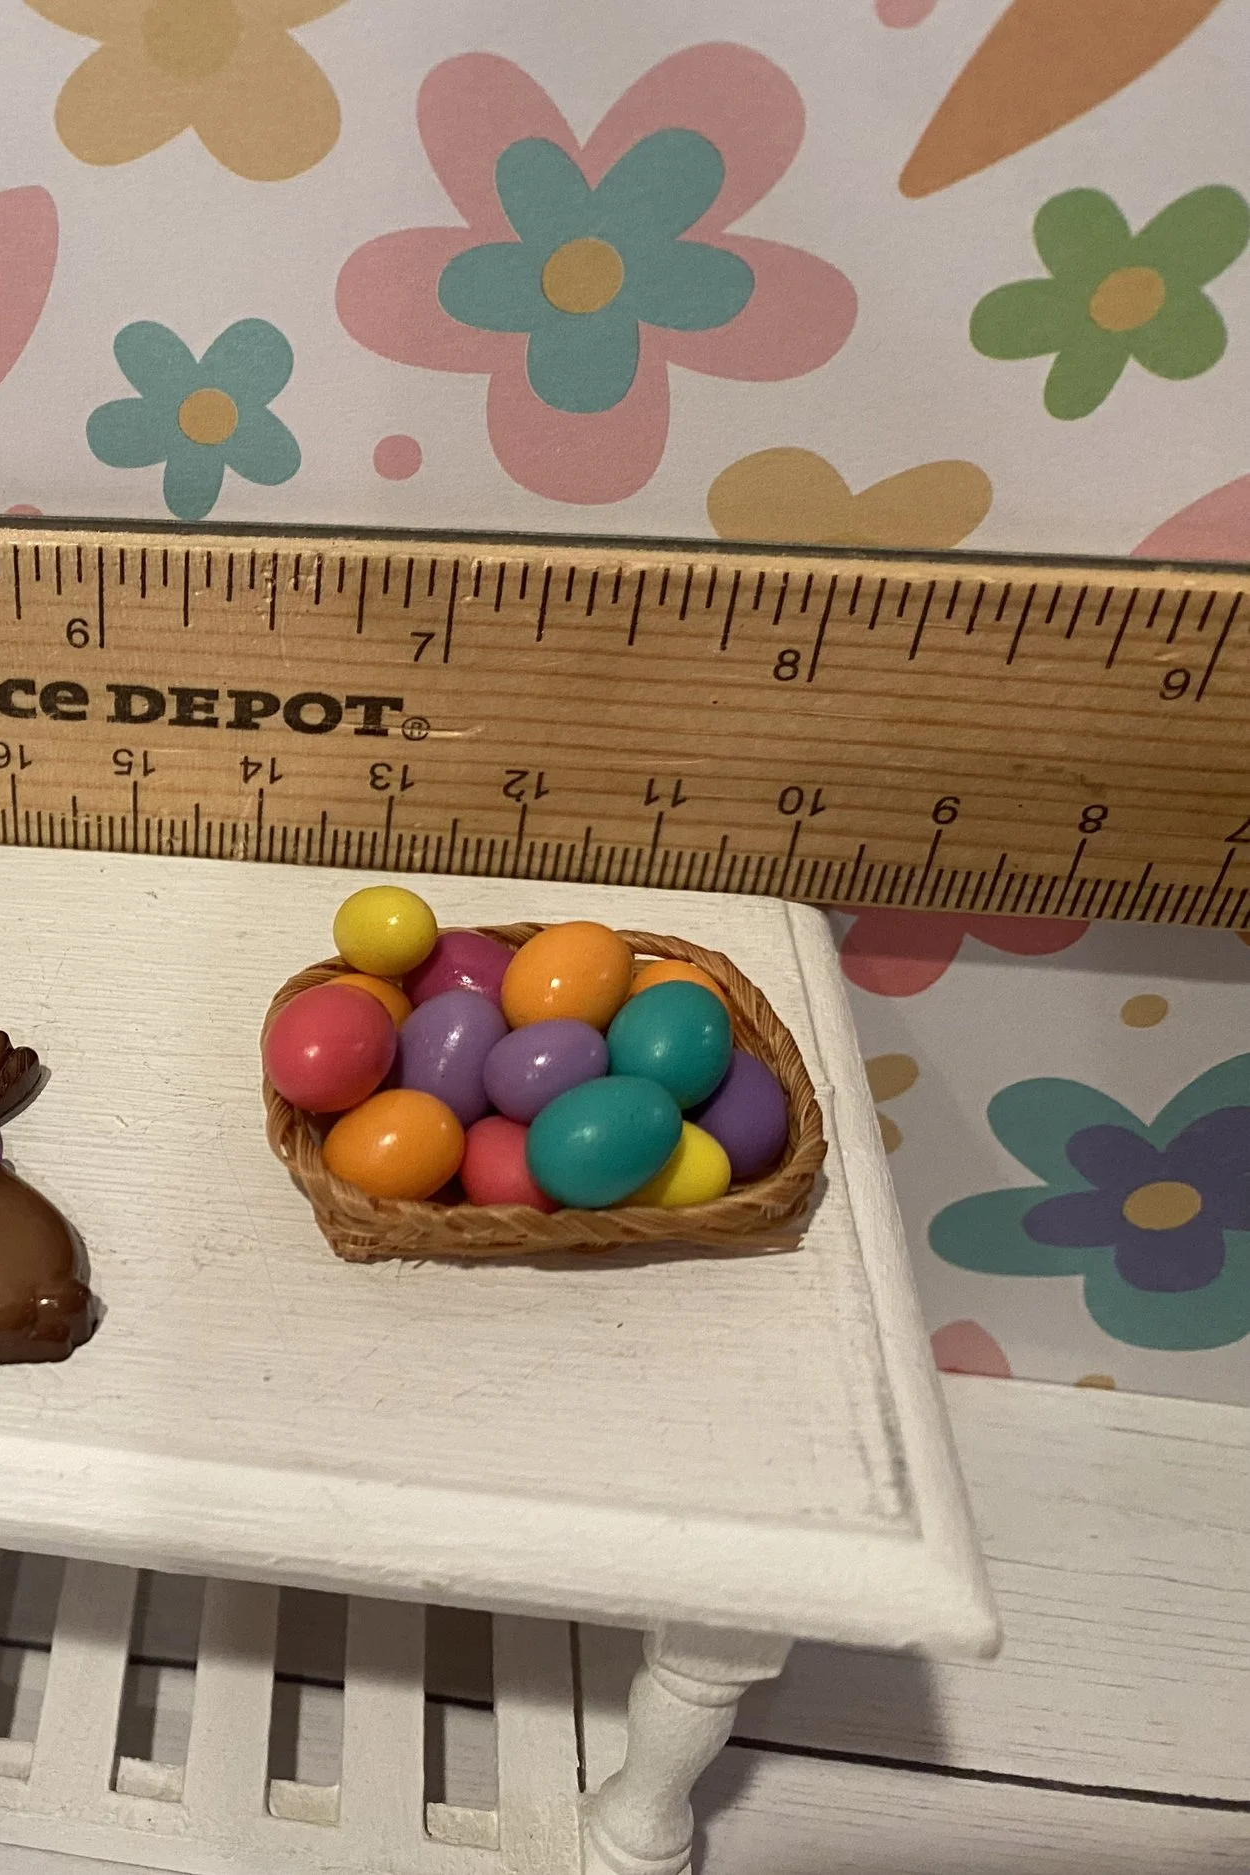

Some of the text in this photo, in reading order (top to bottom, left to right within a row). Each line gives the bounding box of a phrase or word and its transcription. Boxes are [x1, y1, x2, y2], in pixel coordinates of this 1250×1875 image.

[65, 617, 90, 649] 6
[410, 631, 436, 663] 7
[772, 648, 801, 682] 8
[1159, 667, 1191, 701] 9
[112, 748, 156, 778] 15
[239, 755, 284, 785] 14
[369, 762, 418, 792] 13
[502, 769, 550, 802] 12
[643, 777, 691, 809] 11
[777, 785, 827, 817] 10
[931, 795, 962, 825] 9
[1078, 804, 1109, 834] 8
